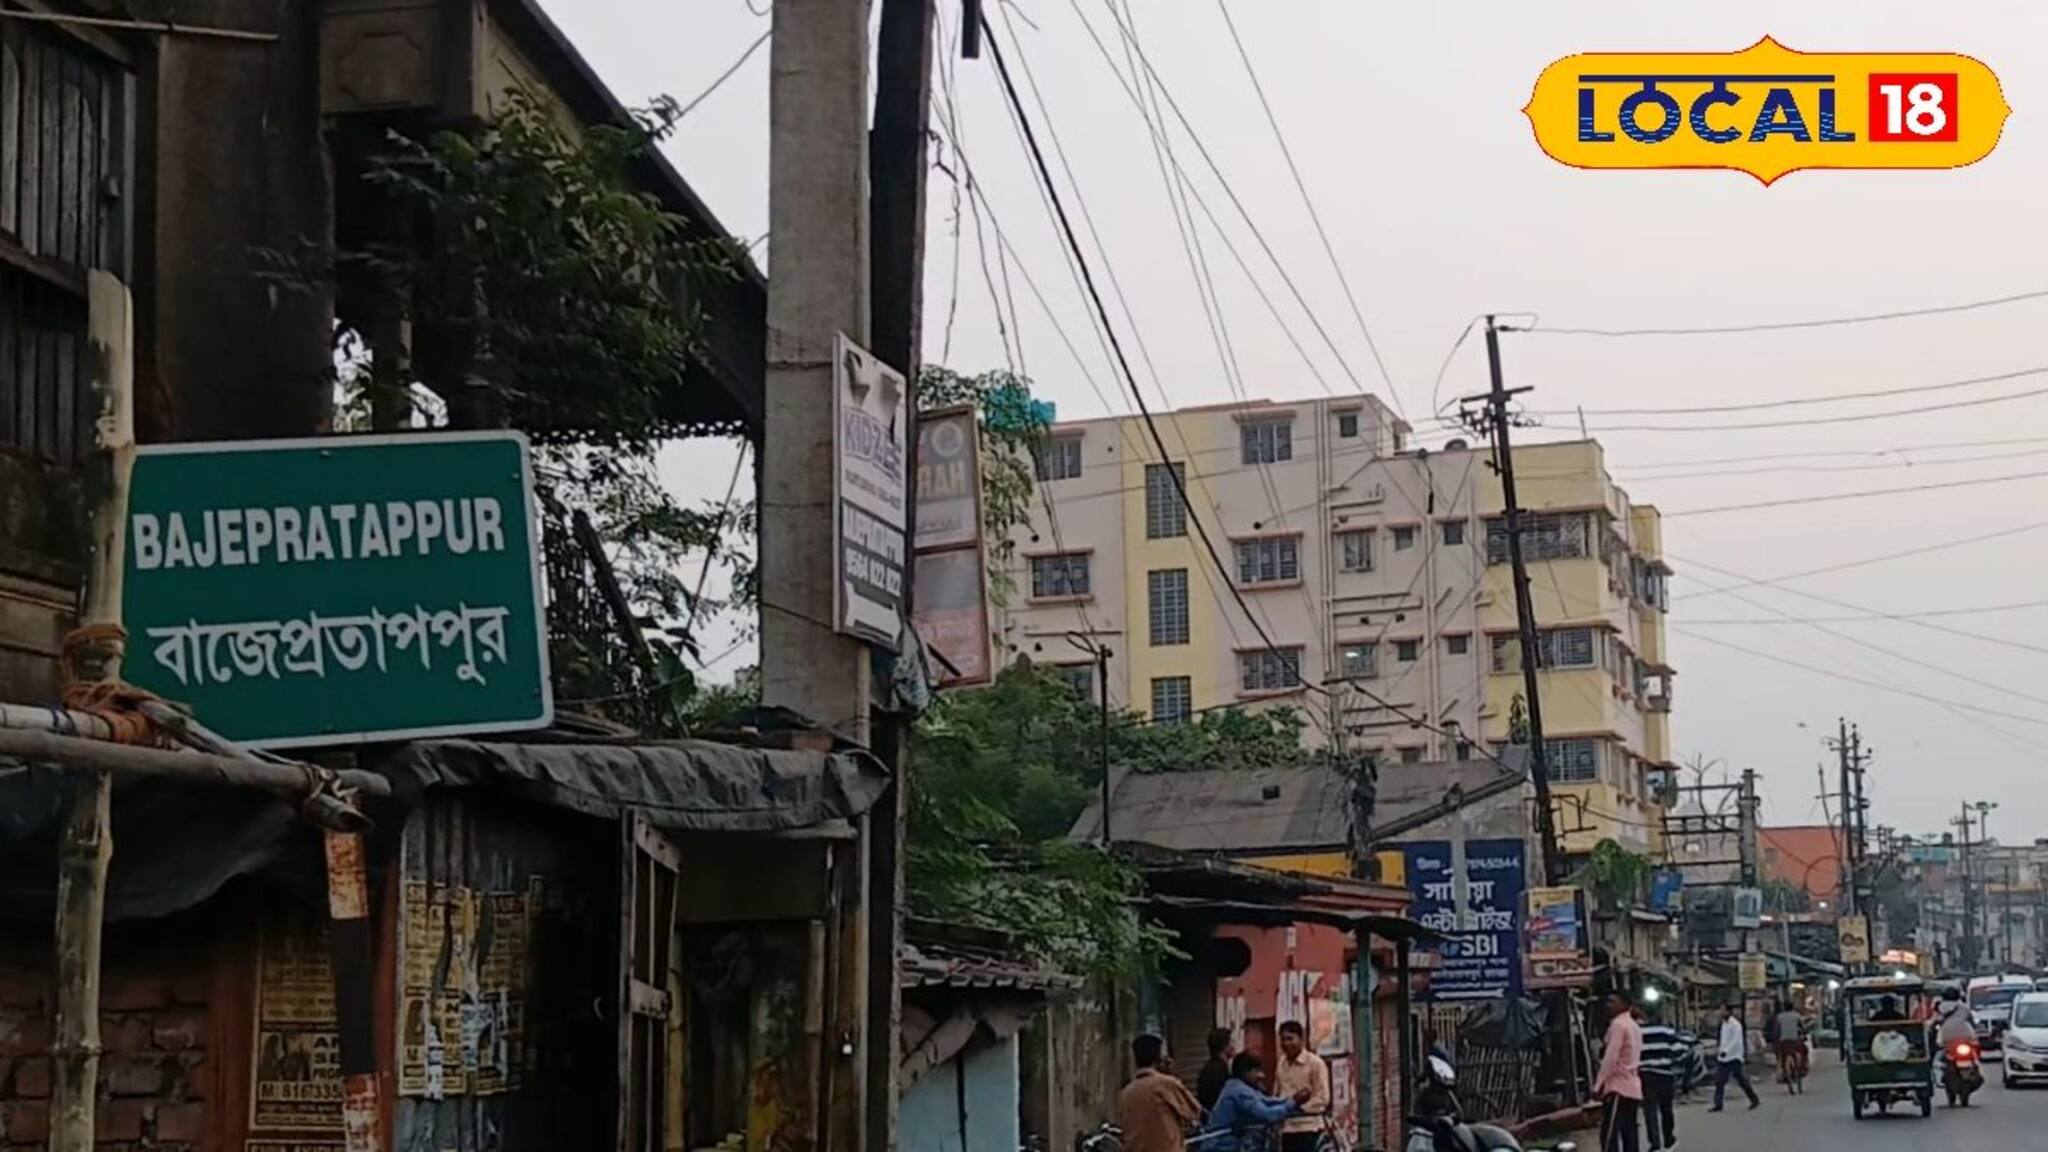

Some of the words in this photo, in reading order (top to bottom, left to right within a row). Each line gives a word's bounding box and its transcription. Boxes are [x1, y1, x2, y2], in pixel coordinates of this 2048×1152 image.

[133, 496, 504, 570] BAJEPRATAPPUR
[146, 601, 510, 686] বাজেপ্রতাপপুর
[1461, 934, 1498, 956] SBI
